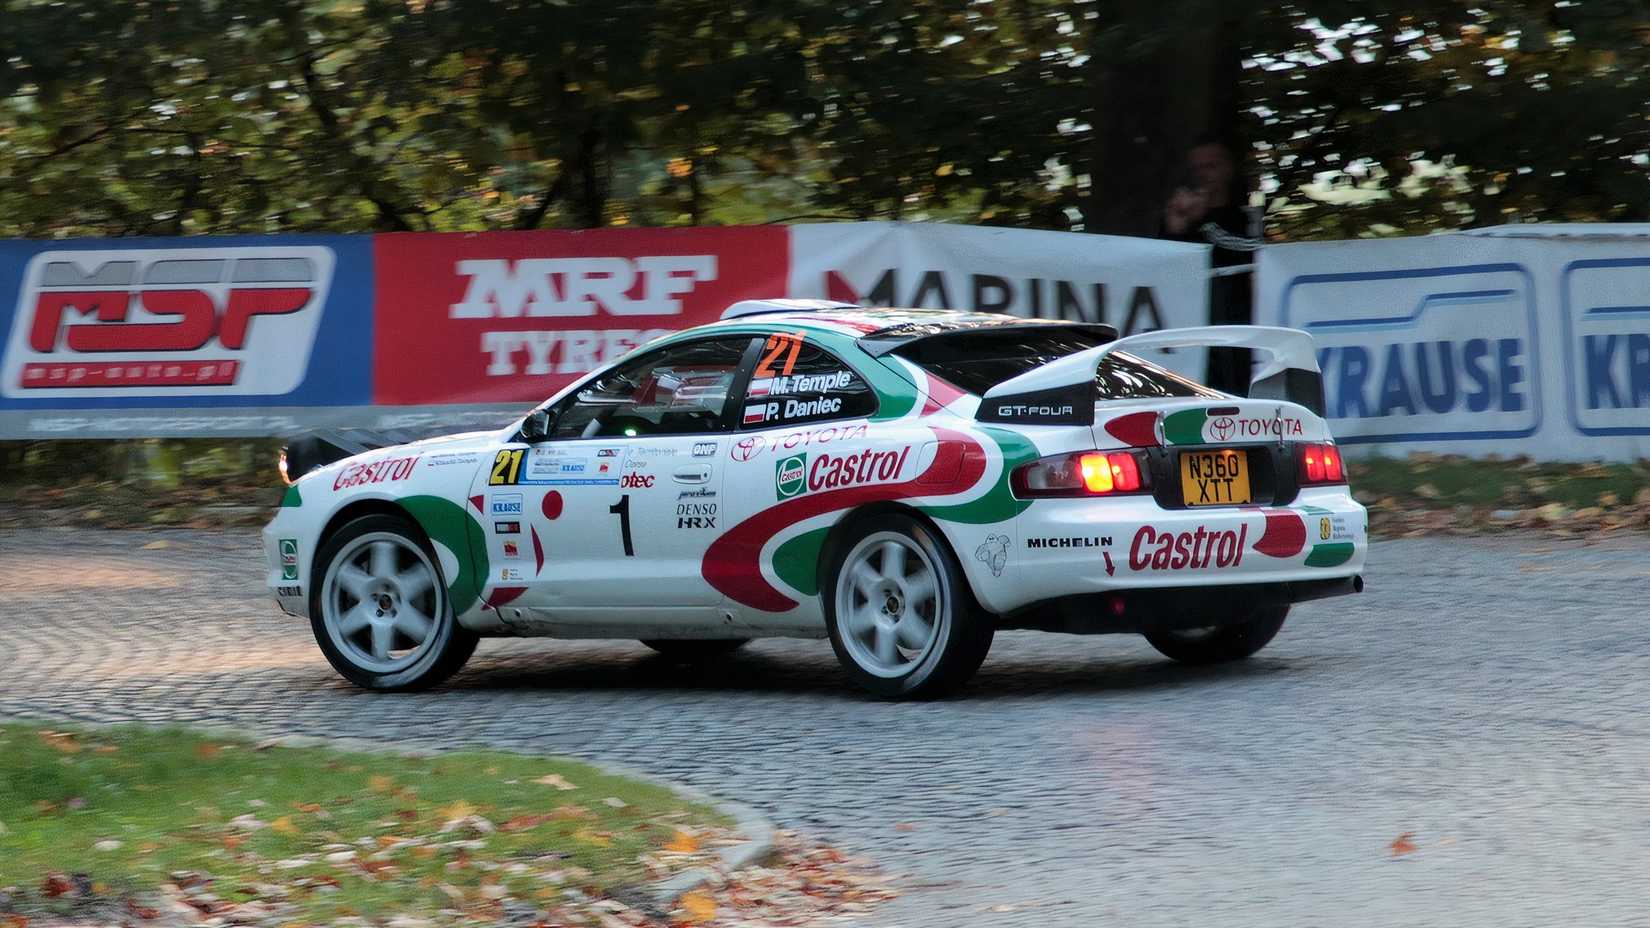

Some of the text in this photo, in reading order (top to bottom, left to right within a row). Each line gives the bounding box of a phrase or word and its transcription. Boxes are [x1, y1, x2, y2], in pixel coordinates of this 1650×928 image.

[449, 255, 718, 319] MRF
[27, 257, 316, 352] MSP
[753, 331, 807, 377] 21
[792, 371, 851, 394] Temple
[766, 395, 842, 421] P. Daniec
[771, 424, 868, 452] TOYOTA
[1239, 417, 1303, 436] TOYOTA
[333, 456, 420, 491] Castrol
[490, 449, 524, 486] 21
[808, 446, 912, 491] Castrol
[1189, 454, 1239, 479] N360
[1198, 478, 1235, 503] XTT
[676, 503, 717, 515] DENSO
[677, 517, 716, 529] HRX
[609, 494, 635, 557] 1
[1027, 536, 1113, 549] MICHELIN
[1128, 523, 1248, 571] Castrol
